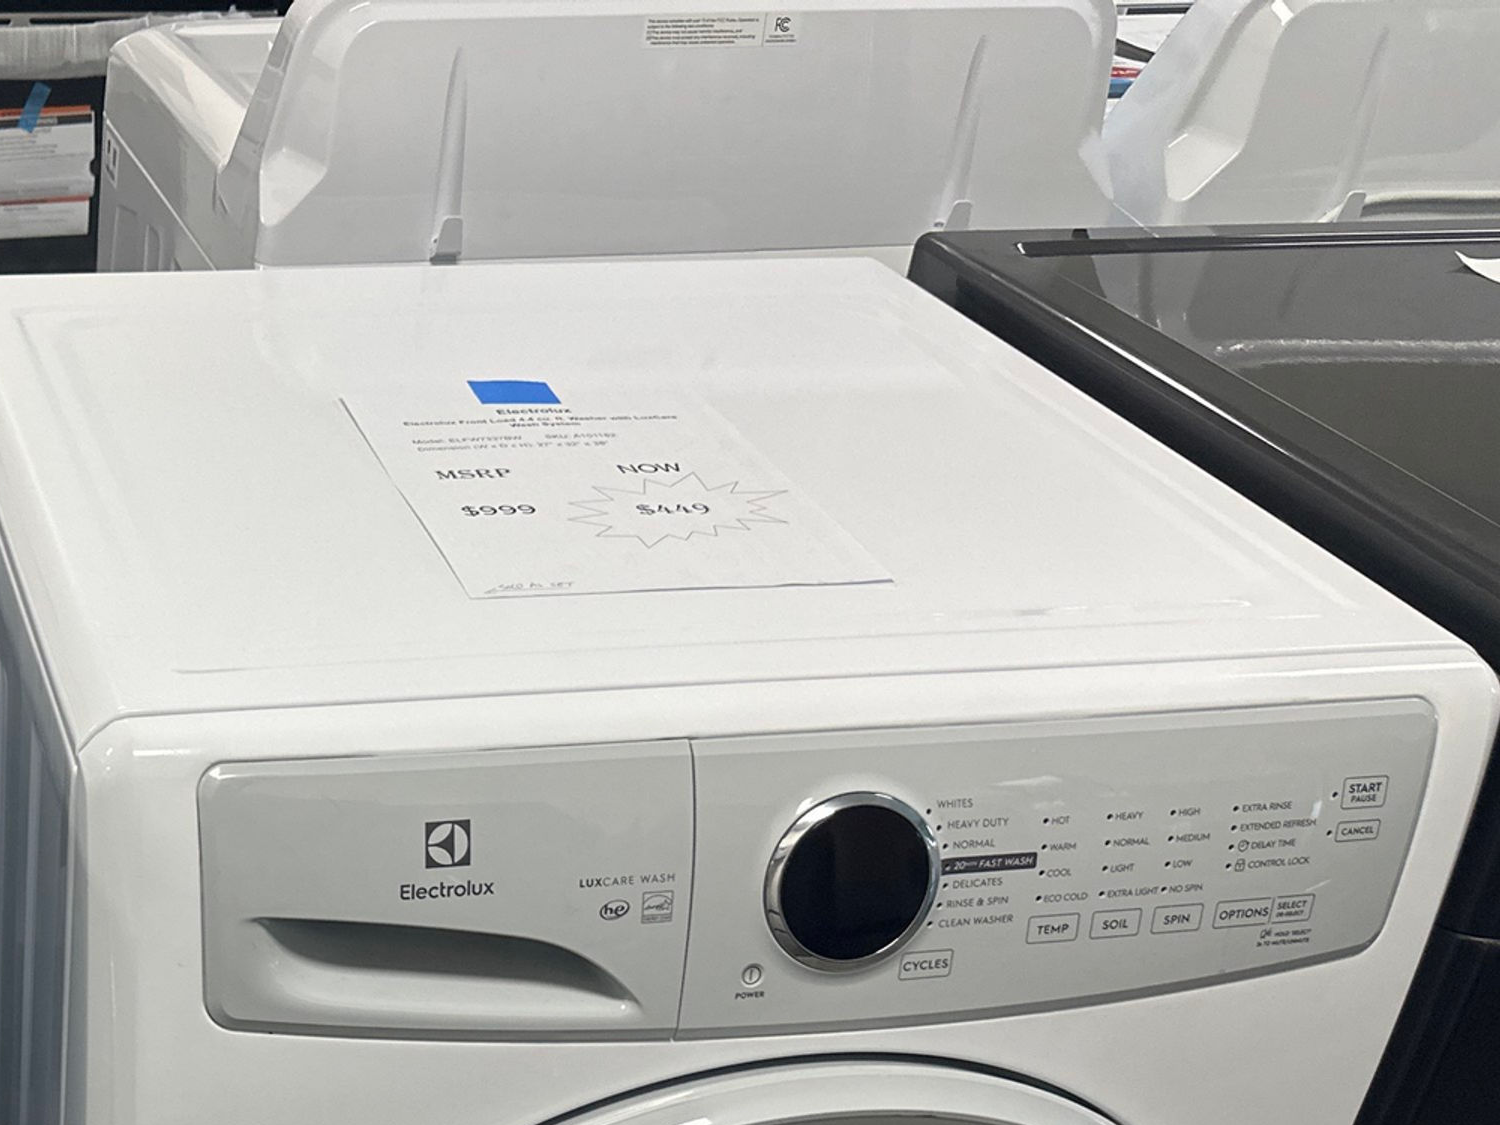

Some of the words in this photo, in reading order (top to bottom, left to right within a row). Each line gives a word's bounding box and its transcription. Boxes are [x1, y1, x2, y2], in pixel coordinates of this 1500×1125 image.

[436, 468, 512, 480] MSRP
[616, 462, 681, 476] NOW
[461, 503, 536, 519] $999
[636, 502, 711, 516] $449
[1349, 782, 1383, 794] START
[1351, 793, 1377, 802] PAUSE
[937, 799, 974, 809] WHITES
[1242, 803, 1267, 813] EXTRA
[1269, 801, 1293, 811] RINSE
[1115, 811, 1144, 821] HEAVY
[1178, 808, 1201, 816] HIGH
[947, 818, 983, 830] HEAVY
[985, 817, 1009, 828] DUTY
[1051, 816, 1070, 824] HOT
[1240, 821, 1282, 832] EXTENDED
[1283, 819, 1317, 829] REFRESH
[1341, 826, 1374, 836] CANCEL
[1113, 838, 1149, 847] NORMAL
[1176, 833, 1210, 842] MEDIUM
[953, 838, 995, 850] NORMAL
[1050, 842, 1077, 851] WARM
[1251, 840, 1277, 850] DELAY
[1278, 838, 1296, 847] TIME
[1005, 856, 1035, 866] WASH
[1172, 859, 1193, 868] LOW
[1248, 858, 1287, 869] CONTROL
[1288, 856, 1310, 865] LOCK
[1046, 868, 1072, 878] COOL
[1110, 863, 1135, 872] LIGHT
[579, 875, 635, 888] LUXCARE
[640, 873, 676, 884] WASH
[953, 877, 1003, 889] DELICATES
[400, 880, 494, 900] Electrolux
[1107, 888, 1133, 898] EXTRA
[1135, 886, 1159, 896] LIGHT
[1169, 885, 1183, 893] NO
[1185, 883, 1203, 892] SPIN
[946, 898, 975, 908] RINSE
[976, 897, 984, 907] &
[986, 895, 1009, 906] SPIN
[1043, 893, 1062, 903] ECO
[1063, 892, 1088, 901] COLD
[1277, 900, 1307, 910] SELECT
[1219, 907, 1269, 920] OPTIONS
[938, 918, 968, 928] CLEAN
[970, 914, 1014, 926] WASHER
[1102, 919, 1128, 930] SOIL
[1163, 914, 1190, 925] SPIN
[1037, 924, 1070, 935] TEMP
[902, 958, 948, 972] CYCLES
[735, 991, 765, 1000] POWER
